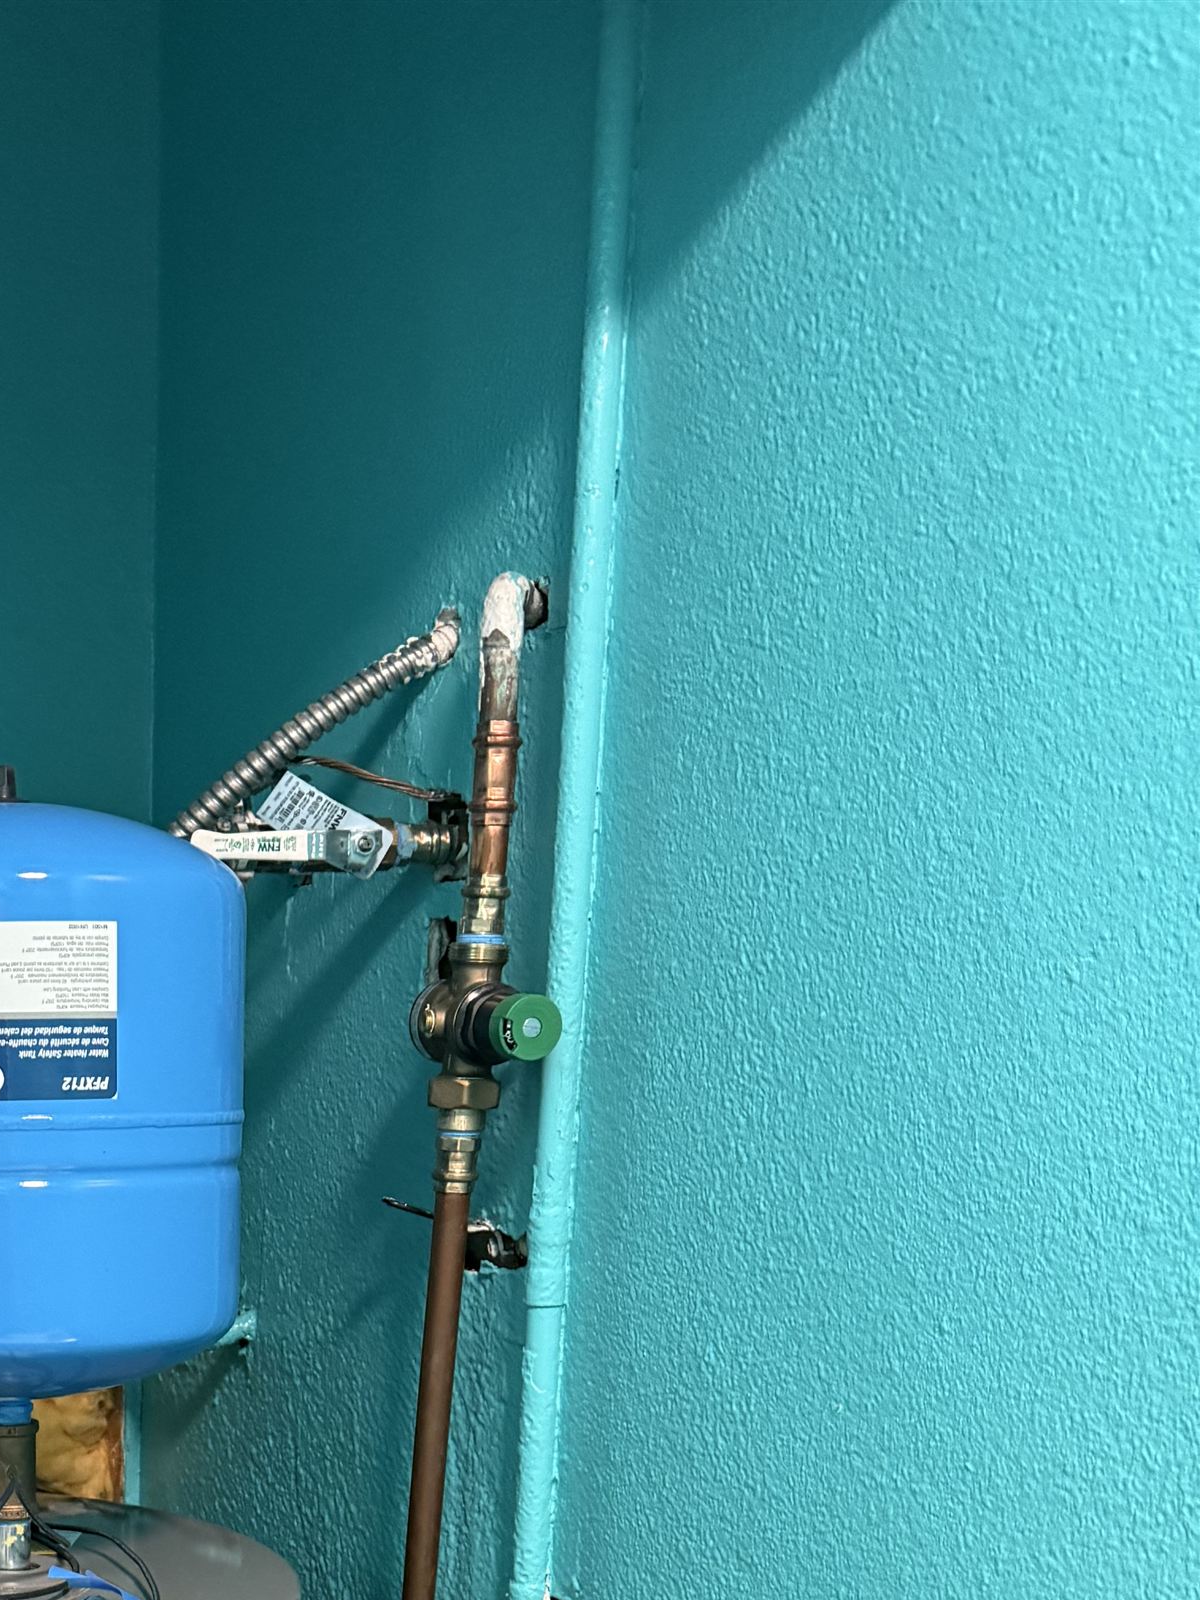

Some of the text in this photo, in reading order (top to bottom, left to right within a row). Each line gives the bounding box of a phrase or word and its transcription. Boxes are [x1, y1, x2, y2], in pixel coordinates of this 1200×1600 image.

[258, 841, 281, 851] FNW
[39, 1038, 49, 1047] du
[93, 1037, 109, 1046] Cuve
[19, 1048, 109, 1059] Water Heater Safety Tank
[62, 1077, 109, 1090] PFXT12
